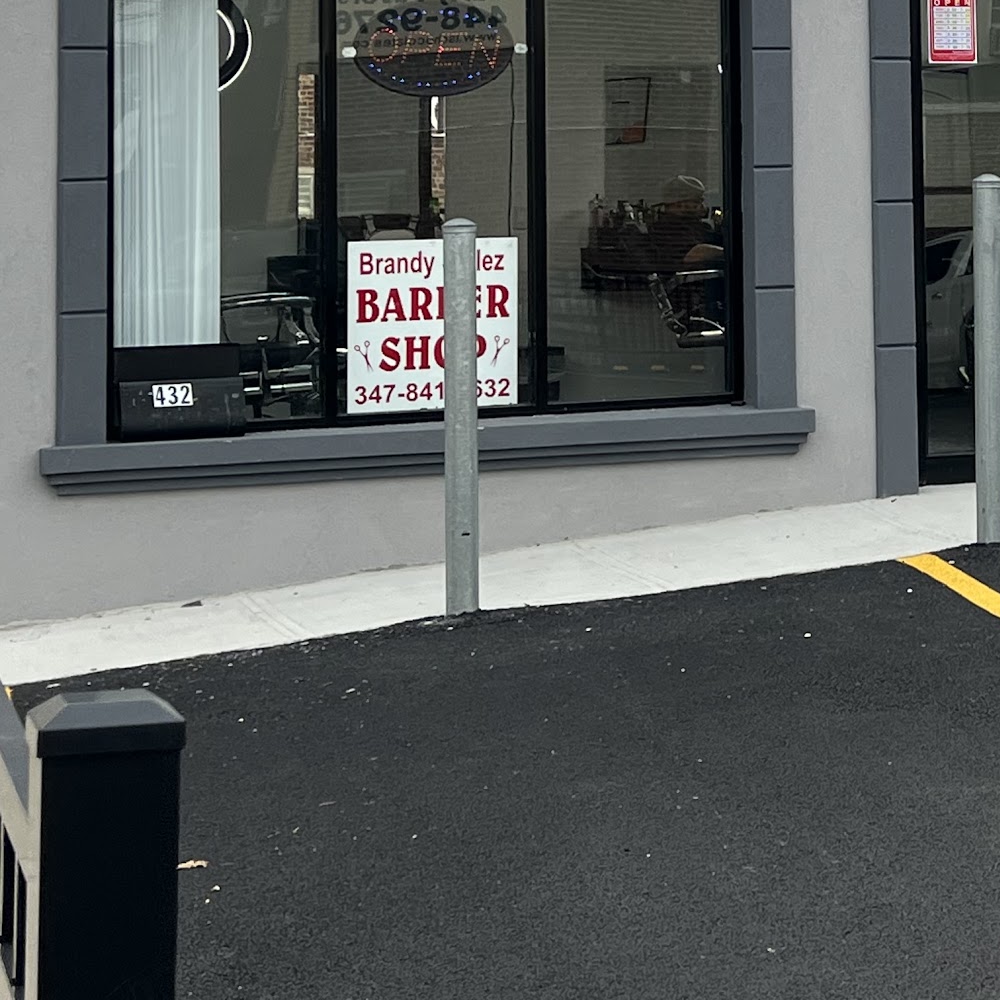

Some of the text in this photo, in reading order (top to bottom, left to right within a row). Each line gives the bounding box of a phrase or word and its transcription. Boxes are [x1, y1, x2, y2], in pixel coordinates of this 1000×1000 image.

[359, 250, 435, 279] Brandy
[155, 385, 191, 405] 432
[354, 378, 511, 405] 347-84132
